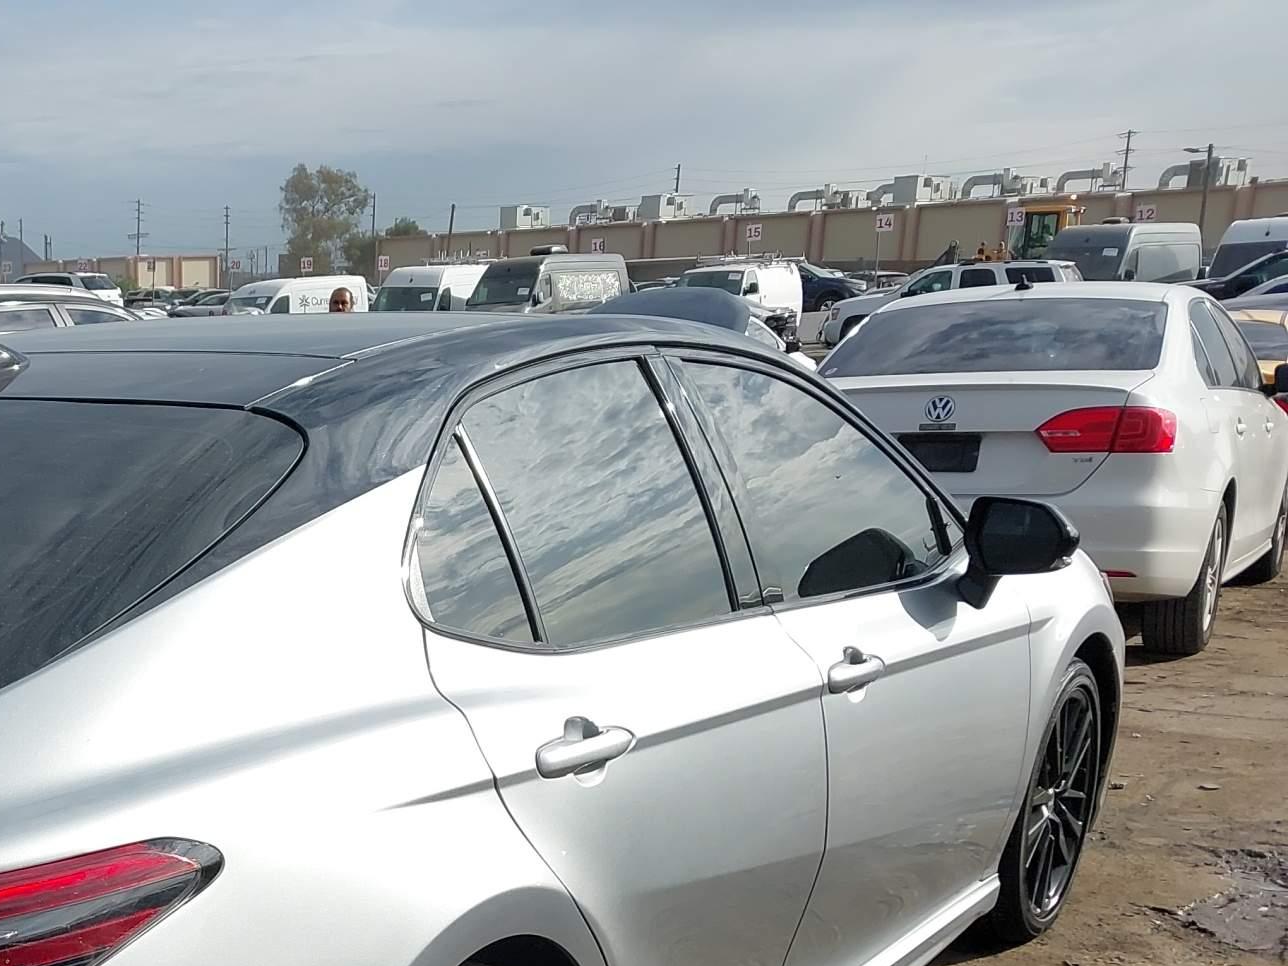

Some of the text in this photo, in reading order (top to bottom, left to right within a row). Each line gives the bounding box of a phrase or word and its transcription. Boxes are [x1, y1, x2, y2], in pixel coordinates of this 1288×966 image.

[1008, 211, 1024, 222] 13
[1137, 208, 1155, 221] 12
[877, 217, 892, 229] 14
[747, 226, 761, 238] 15
[231, 260, 241, 270] 20
[302, 260, 312, 270] 19
[379, 258, 389, 268] 18
